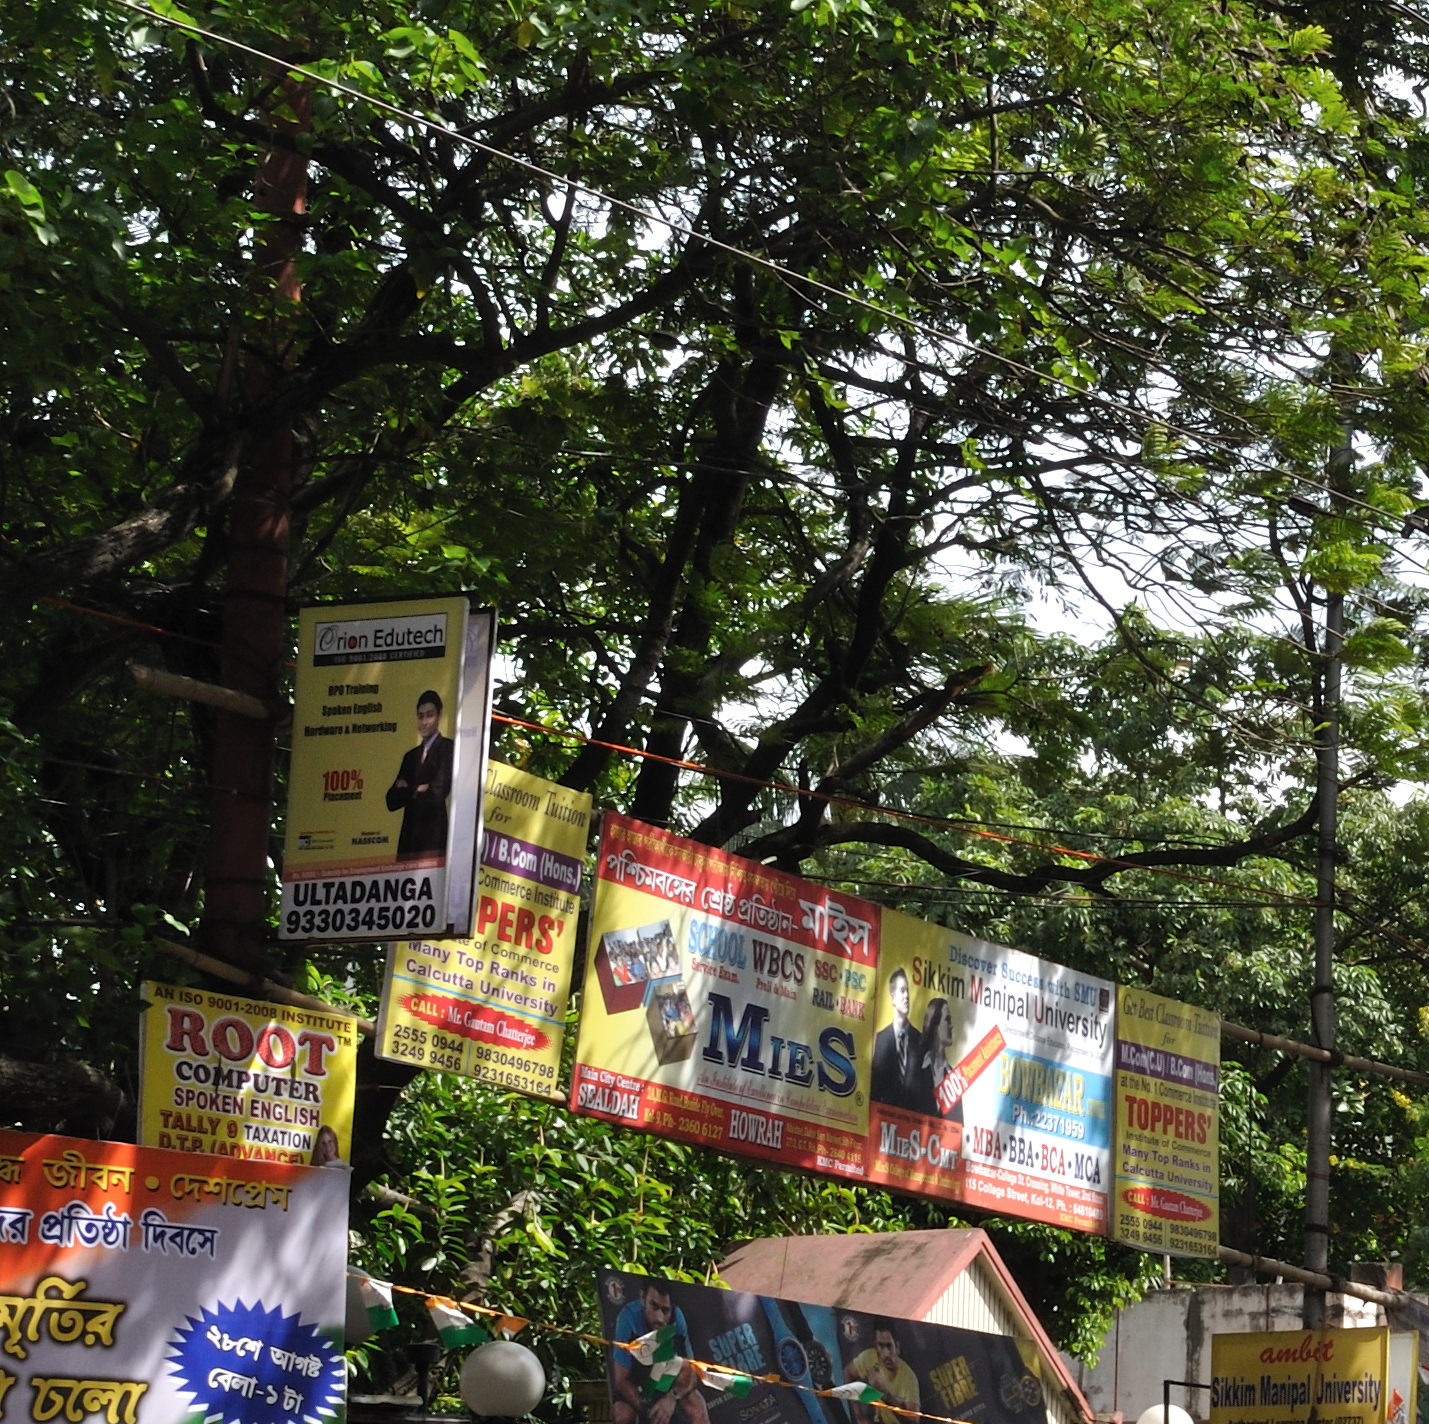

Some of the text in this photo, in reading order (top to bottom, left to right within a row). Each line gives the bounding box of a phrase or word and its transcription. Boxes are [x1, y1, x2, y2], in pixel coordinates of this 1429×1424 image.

[318, 624, 443, 651] Orion Edutech
[346, 684, 379, 695] Training
[322, 702, 382, 717] Spoken English
[304, 724, 344, 737] Hardware
[323, 769, 363, 792] 100%
[490, 805, 512, 825] for
[545, 790, 586, 827] Tuition
[498, 838, 538, 872] B.Com
[540, 851, 582, 893] (Hons.)
[293, 877, 433, 907] ULTADANGA
[533, 884, 575, 915] Institute
[606, 849, 697, 905] পশ্চিমবঙ্গের
[798, 895, 872, 957] মাইস
[286, 904, 436, 935] 9330345020
[408, 940, 556, 995] Many Top Ranks in
[491, 942, 560, 975] Commerce
[688, 918, 838, 987] SCHOOL WBCS SSC
[406, 958, 559, 1018] Calcutta University
[949, 945, 1098, 1006] Discover Success with SMU
[153, 985, 352, 1034] AN ISO 9001-2008 INSTITUTE
[812, 987, 835, 1012] RAIL
[912, 956, 965, 1000] Sikkim
[970, 974, 1029, 1022] Manipal
[1034, 994, 1107, 1049] University
[393, 1024, 464, 1055] 2555 0944
[410, 996, 536, 1047] CALL Gautam Chatterjee
[165, 1005, 336, 1077] ROOT
[337, 1035, 352, 1047] TM
[391, 1040, 462, 1071] 3249 9456
[472, 1062, 552, 1097] 9231653164
[475, 1045, 555, 1080] 9830496798
[174, 1060, 322, 1104] COMPUTER
[938, 1066, 969, 1110] 100%
[999, 1051, 1085, 1117] BOWBAZAR
[174, 1086, 320, 1128] SPOKEN ENGLISH
[577, 1082, 640, 1121] SEALDAH
[1124, 1094, 1212, 1145] TOPPERS'
[160, 1109, 312, 1150] TALLY TAXATION
[701, 1122, 725, 1139] 6127
[728, 1108, 784, 1150] HOWRAH
[210, 1138, 305, 1166] (ADVANCE)
[973, 1126, 1101, 1185] MBA BBA BCA MCA
[43, 1150, 293, 1212] জীবন দেশপ্রেম
[978, 1181, 1005, 1199] College
[40, 1200, 131, 1249] প্রতিষ্ঠা
[141, 1208, 220, 1259] দিবসে
[205, 1324, 264, 1362] ২৮শে
[708, 1322, 761, 1362] SUPER
[1260, 1333, 1335, 1365] ambit
[928, 1355, 973, 1392] SUPER
[281, 1385, 305, 1416] টা
[940, 1378, 980, 1411] FIBRE
[1211, 1374, 1311, 1413] Sikkim Manipal
